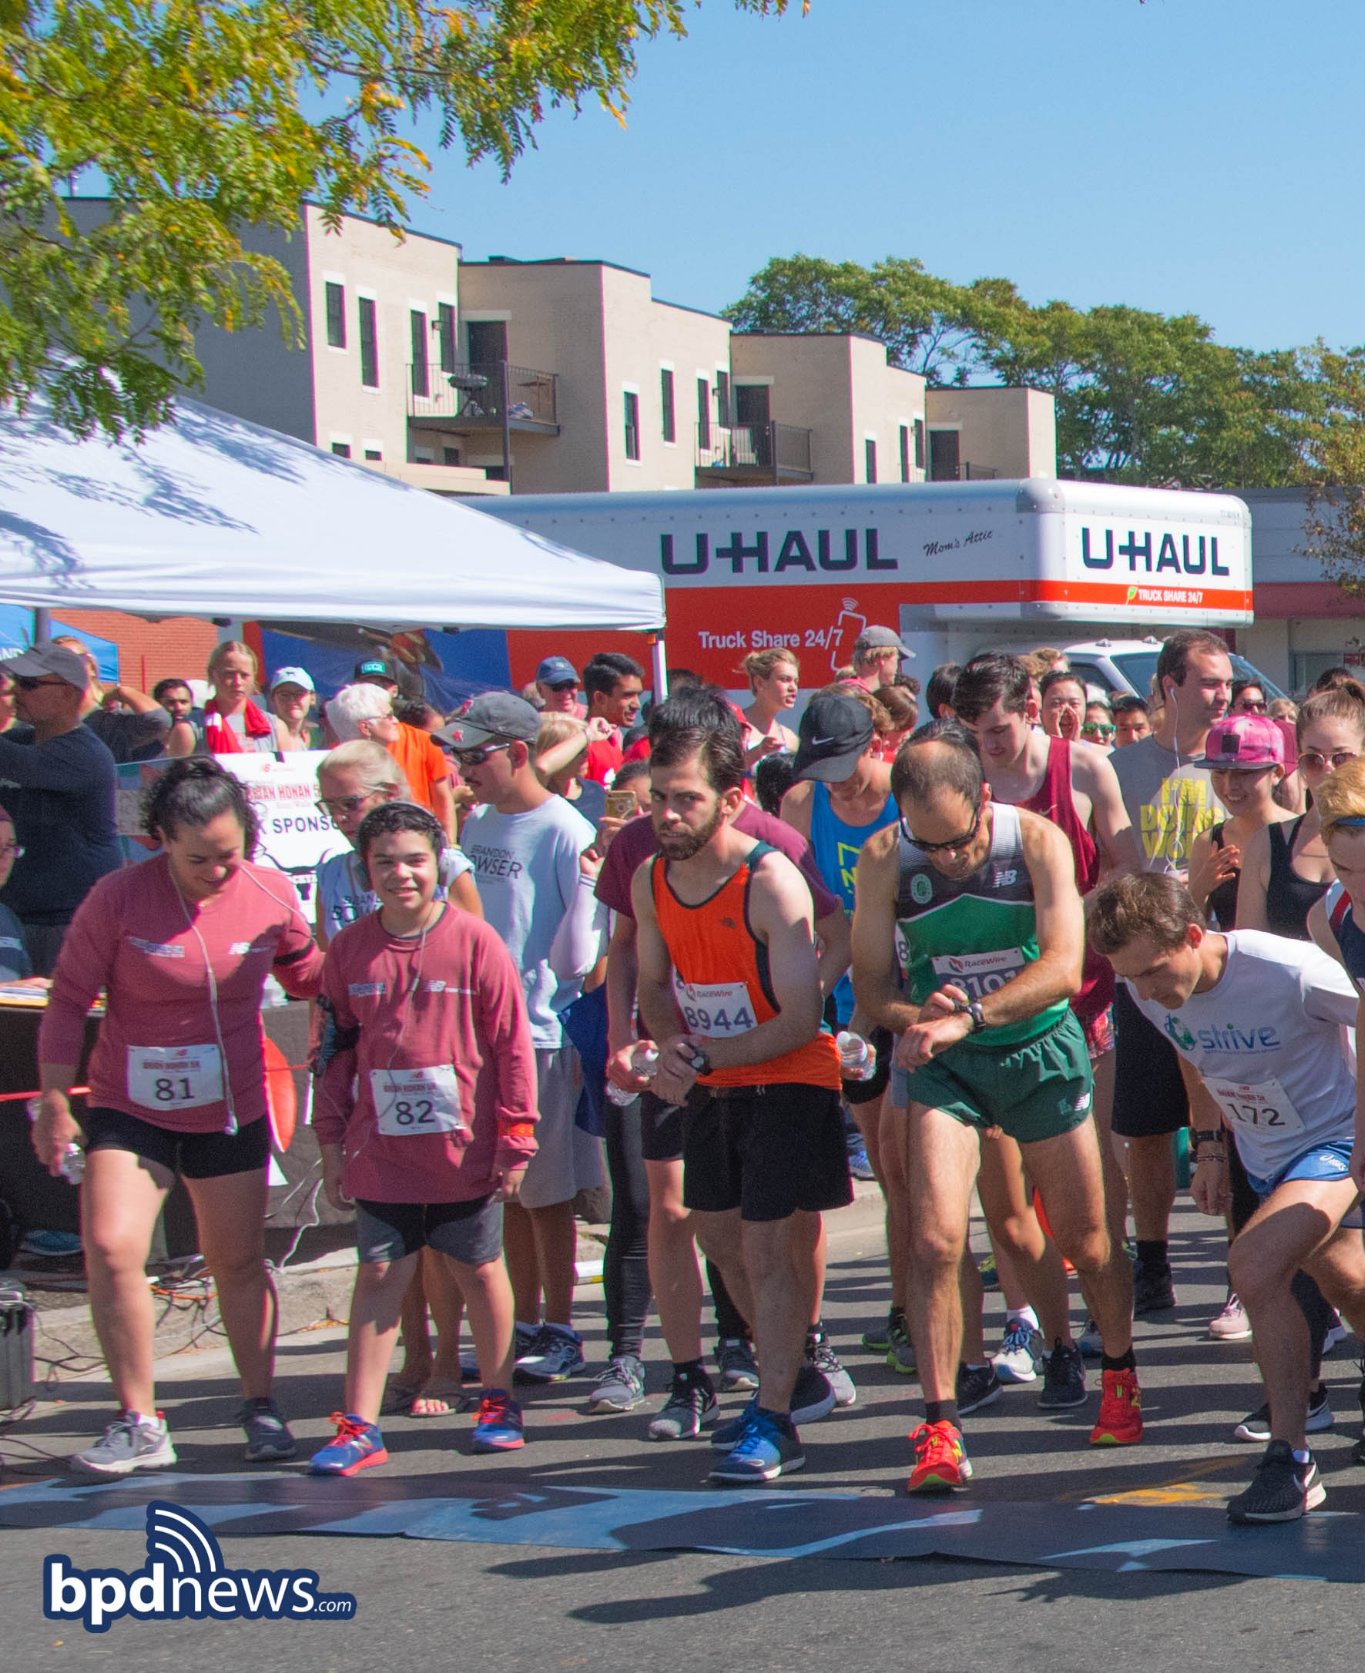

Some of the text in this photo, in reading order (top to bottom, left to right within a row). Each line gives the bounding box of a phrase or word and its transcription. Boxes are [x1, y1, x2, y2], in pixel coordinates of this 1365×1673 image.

[660, 528, 899, 576] U-HAUL
[922, 529, 993, 557] Mom's Attic
[1081, 526, 1230, 577] U-HAUL
[1138, 588, 1203, 605] TRUCK SHARE 24/7
[698, 625, 844, 650] Truck Share 24/7
[278, 784, 311, 799] HONAN
[964, 956, 1008, 969] RaceWire
[684, 1006, 753, 1031] 8944
[1197, 1023, 1280, 1050] strive
[155, 1078, 195, 1101] 81
[395, 1100, 436, 1126] 82
[1227, 1103, 1286, 1127] 172
